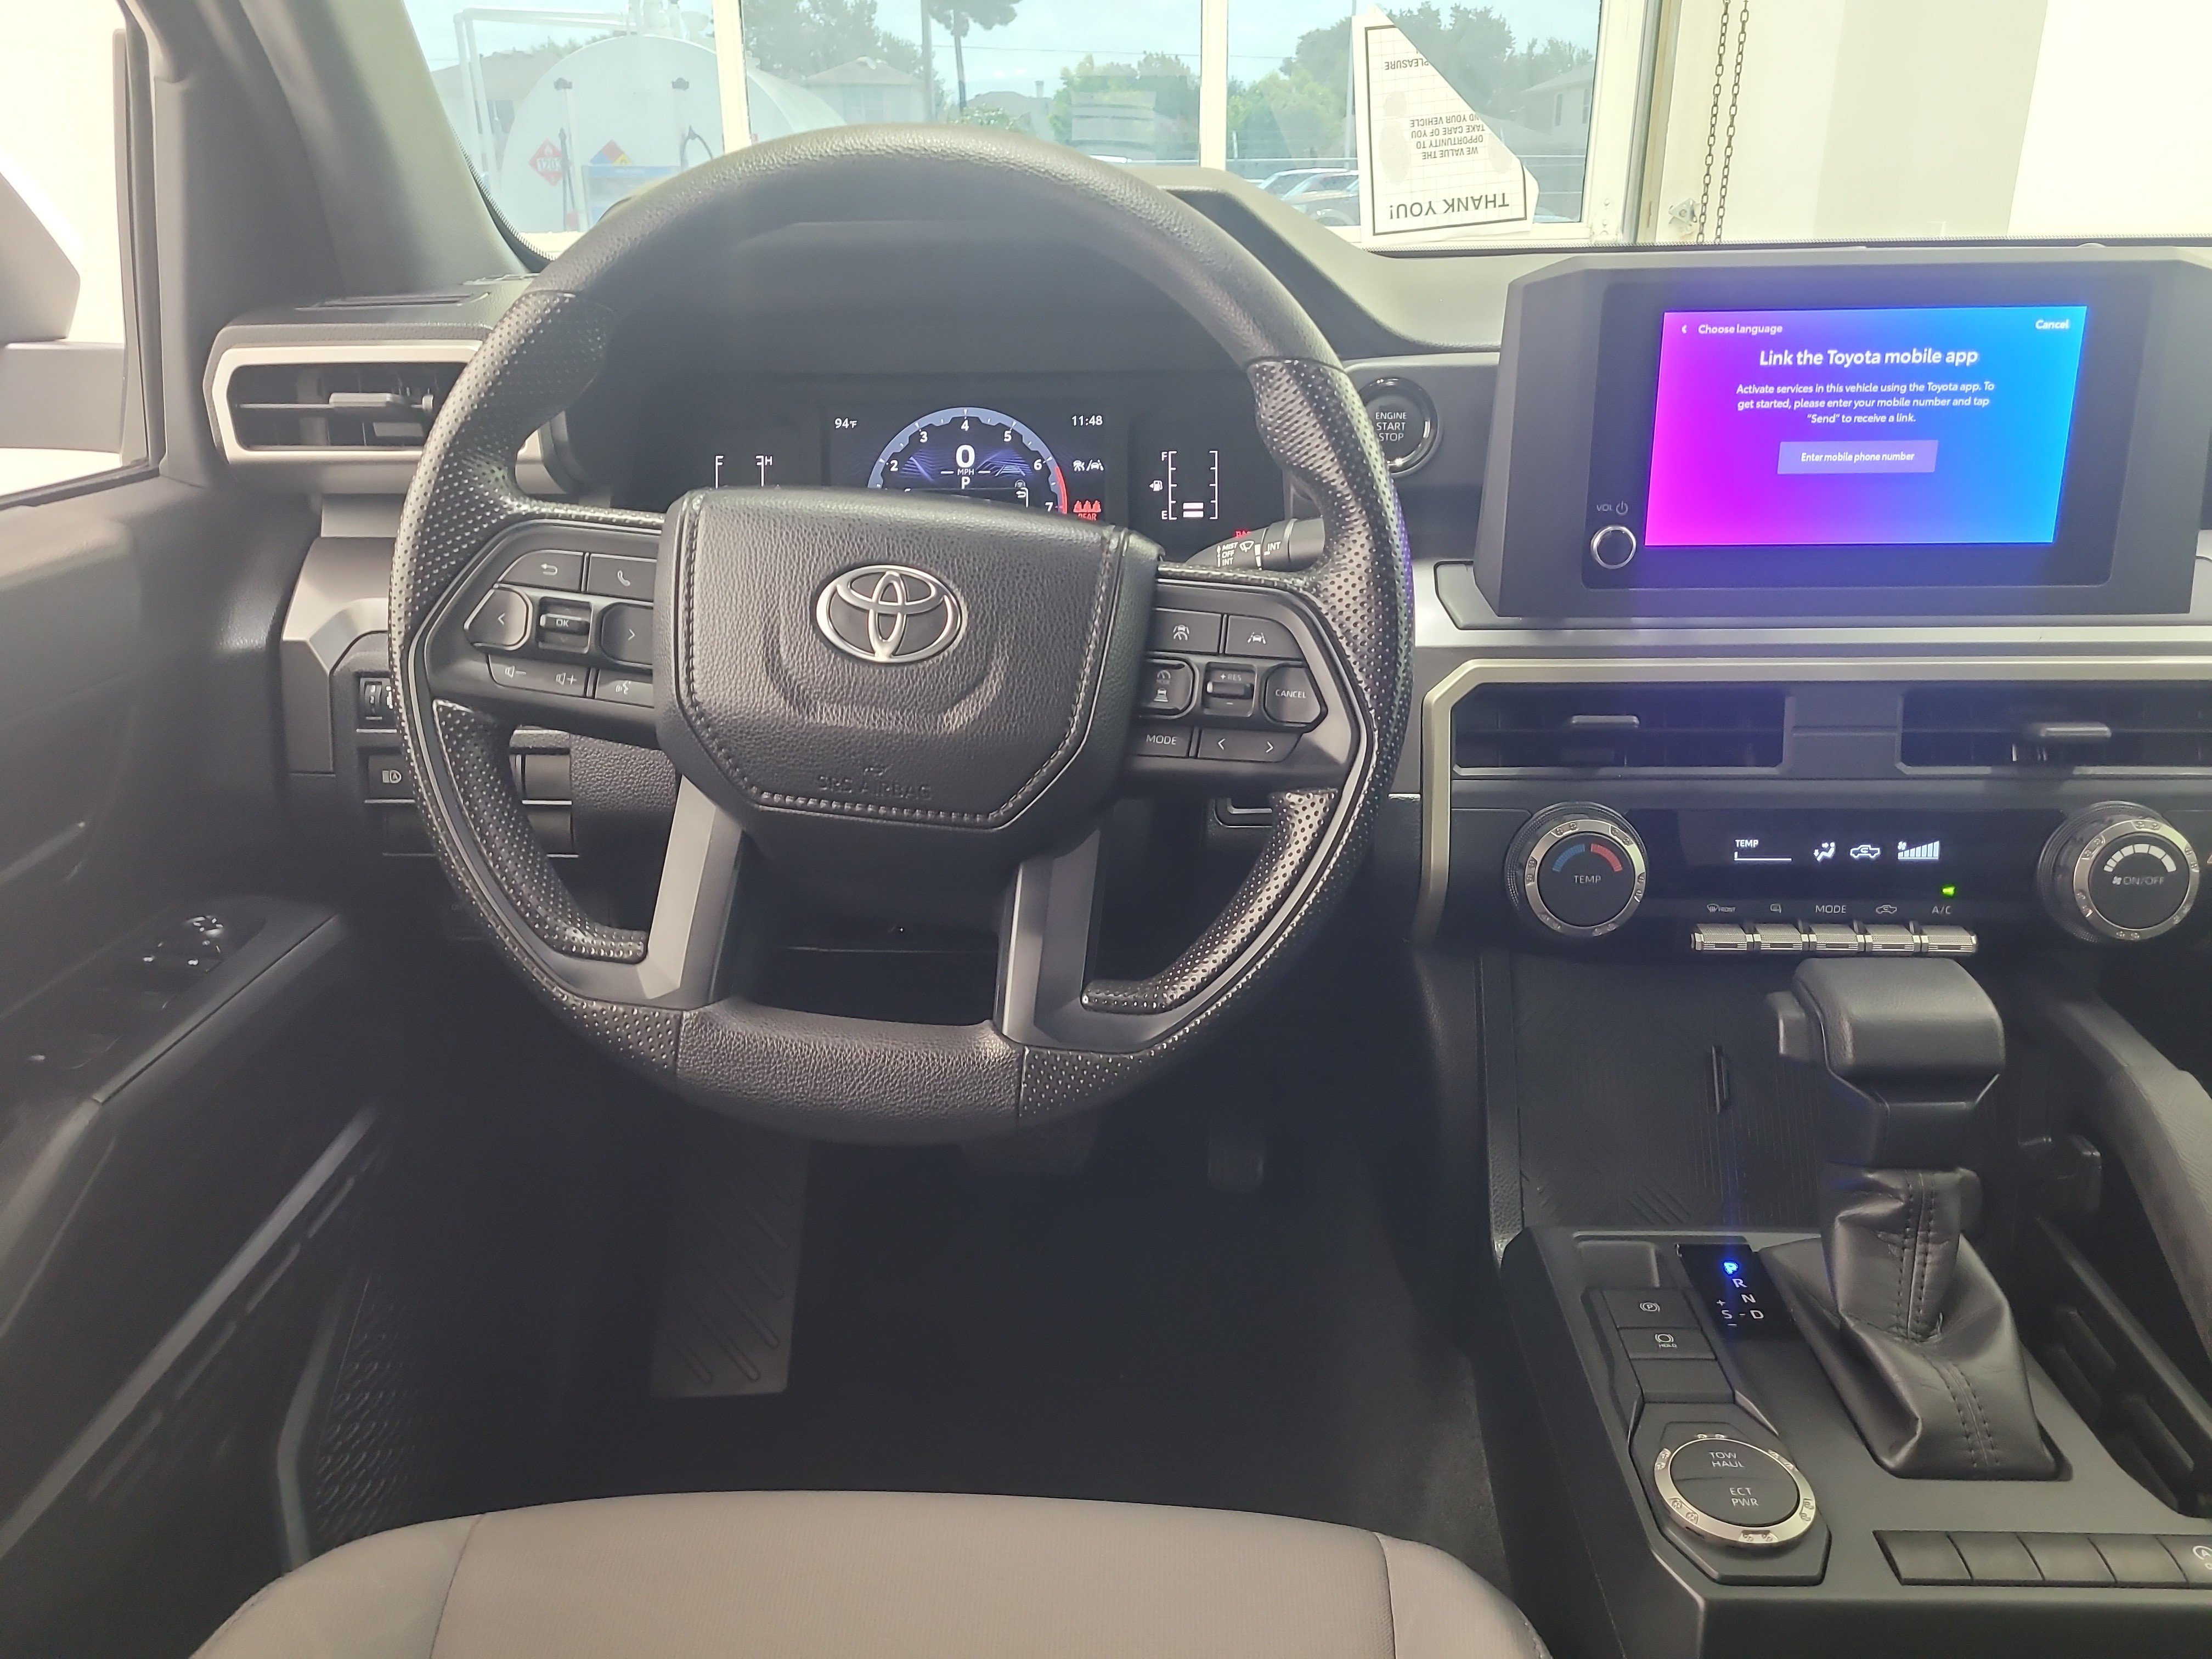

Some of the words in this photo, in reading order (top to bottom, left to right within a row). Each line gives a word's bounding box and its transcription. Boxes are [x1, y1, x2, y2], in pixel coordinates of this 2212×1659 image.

[1410, 117, 1443, 127] VEHICLE
[1446, 115, 1467, 123] YOUR
[1430, 128, 1440, 137] OF
[1442, 126, 1463, 135] CARE
[1466, 124, 1486, 133] TAKE
[1411, 130, 1427, 139] YOU
[1417, 140, 1426, 149] TO
[1429, 135, 1483, 148] OPPORTUNITY
[1440, 148, 1464, 157] VALUE
[1466, 146, 1479, 155] WE
[1422, 151, 1437, 160] THE
[1443, 193, 1509, 213] THANK
[1390, 201, 1437, 219] YOU!
[2035, 319, 2069, 329] Cancel
[1698, 324, 1735, 334] Choose
[1736, 324, 1783, 335] language
[1759, 349, 1792, 366] Link
[1796, 350, 1823, 365] the
[1827, 349, 1881, 368] Toyota
[1884, 348, 1942, 364] mobile
[1945, 351, 1979, 366] app
[1736, 384, 1774, 394] Activate
[1776, 384, 1813, 393] services
[1815, 383, 1824, 393] in
[1826, 383, 1843, 393] this
[1845, 383, 1878, 392] vehicle
[1880, 383, 1906, 394] using
[1909, 382, 1925, 392] the
[1927, 382, 1958, 393] Toyota
[1960, 383, 1981, 393] app.
[1984, 381, 1994, 391] To
[1737, 399, 1754, 411] get
[1756, 398, 1791, 409] started,
[1793, 398, 1825, 410] please
[1827, 399, 1852, 407] enter
[1853, 399, 1875, 409] your
[1877, 397, 1910, 407] mobile
[1912, 397, 1950, 407] number
[1953, 396, 1971, 406] and
[1973, 397, 1990, 408] tap
[1072, 415, 1103, 426] 11:48
[1842, 414, 1852, 423] to
[1854, 413, 1886, 422] receive
[1897, 413, 1916, 422] link.
[961, 420, 969, 431] 4
[1376, 422, 1406, 431] START
[919, 431, 928, 442] 3
[1003, 431, 1012, 442] 5
[1379, 433, 1404, 442] STOP
[765, 456, 772, 465] H
[1161, 452, 1167, 461] F
[1801, 453, 1824, 461] Enter
[1824, 452, 1853, 461] mobile
[1854, 452, 1880, 463] phone
[1881, 452, 1915, 460] number
[890, 460, 898, 471] 2
[1034, 459, 1042, 470] 6
[961, 477, 970, 489] P
[1045, 503, 1053, 512] 7
[1161, 510, 1167, 520] E
[1222, 542, 1238, 551] MIST
[1268, 541, 1281, 551] INT
[1222, 550, 1234, 558] OFF
[1222, 557, 1233, 566] INT
[556, 619, 569, 628] OK
[1276, 689, 1306, 698] CANCEL
[1146, 735, 1177, 745] MODE
[1735, 839, 1758, 848] TEMP
[1575, 875, 1601, 884] TEMP
[2123, 877, 2164, 885] ON/OFF
[1815, 905, 1846, 913] MODE
[1932, 905, 1951, 915] A/C
[1723, 1261, 1739, 1274] P
[1733, 1278, 1747, 1288] R
[1741, 1294, 1756, 1304] N
[1722, 1310, 1733, 1319] S
[1750, 1310, 1764, 1319] D
[1730, 1487, 1752, 1496] ECT
[1732, 1498, 1759, 1506] PWR
